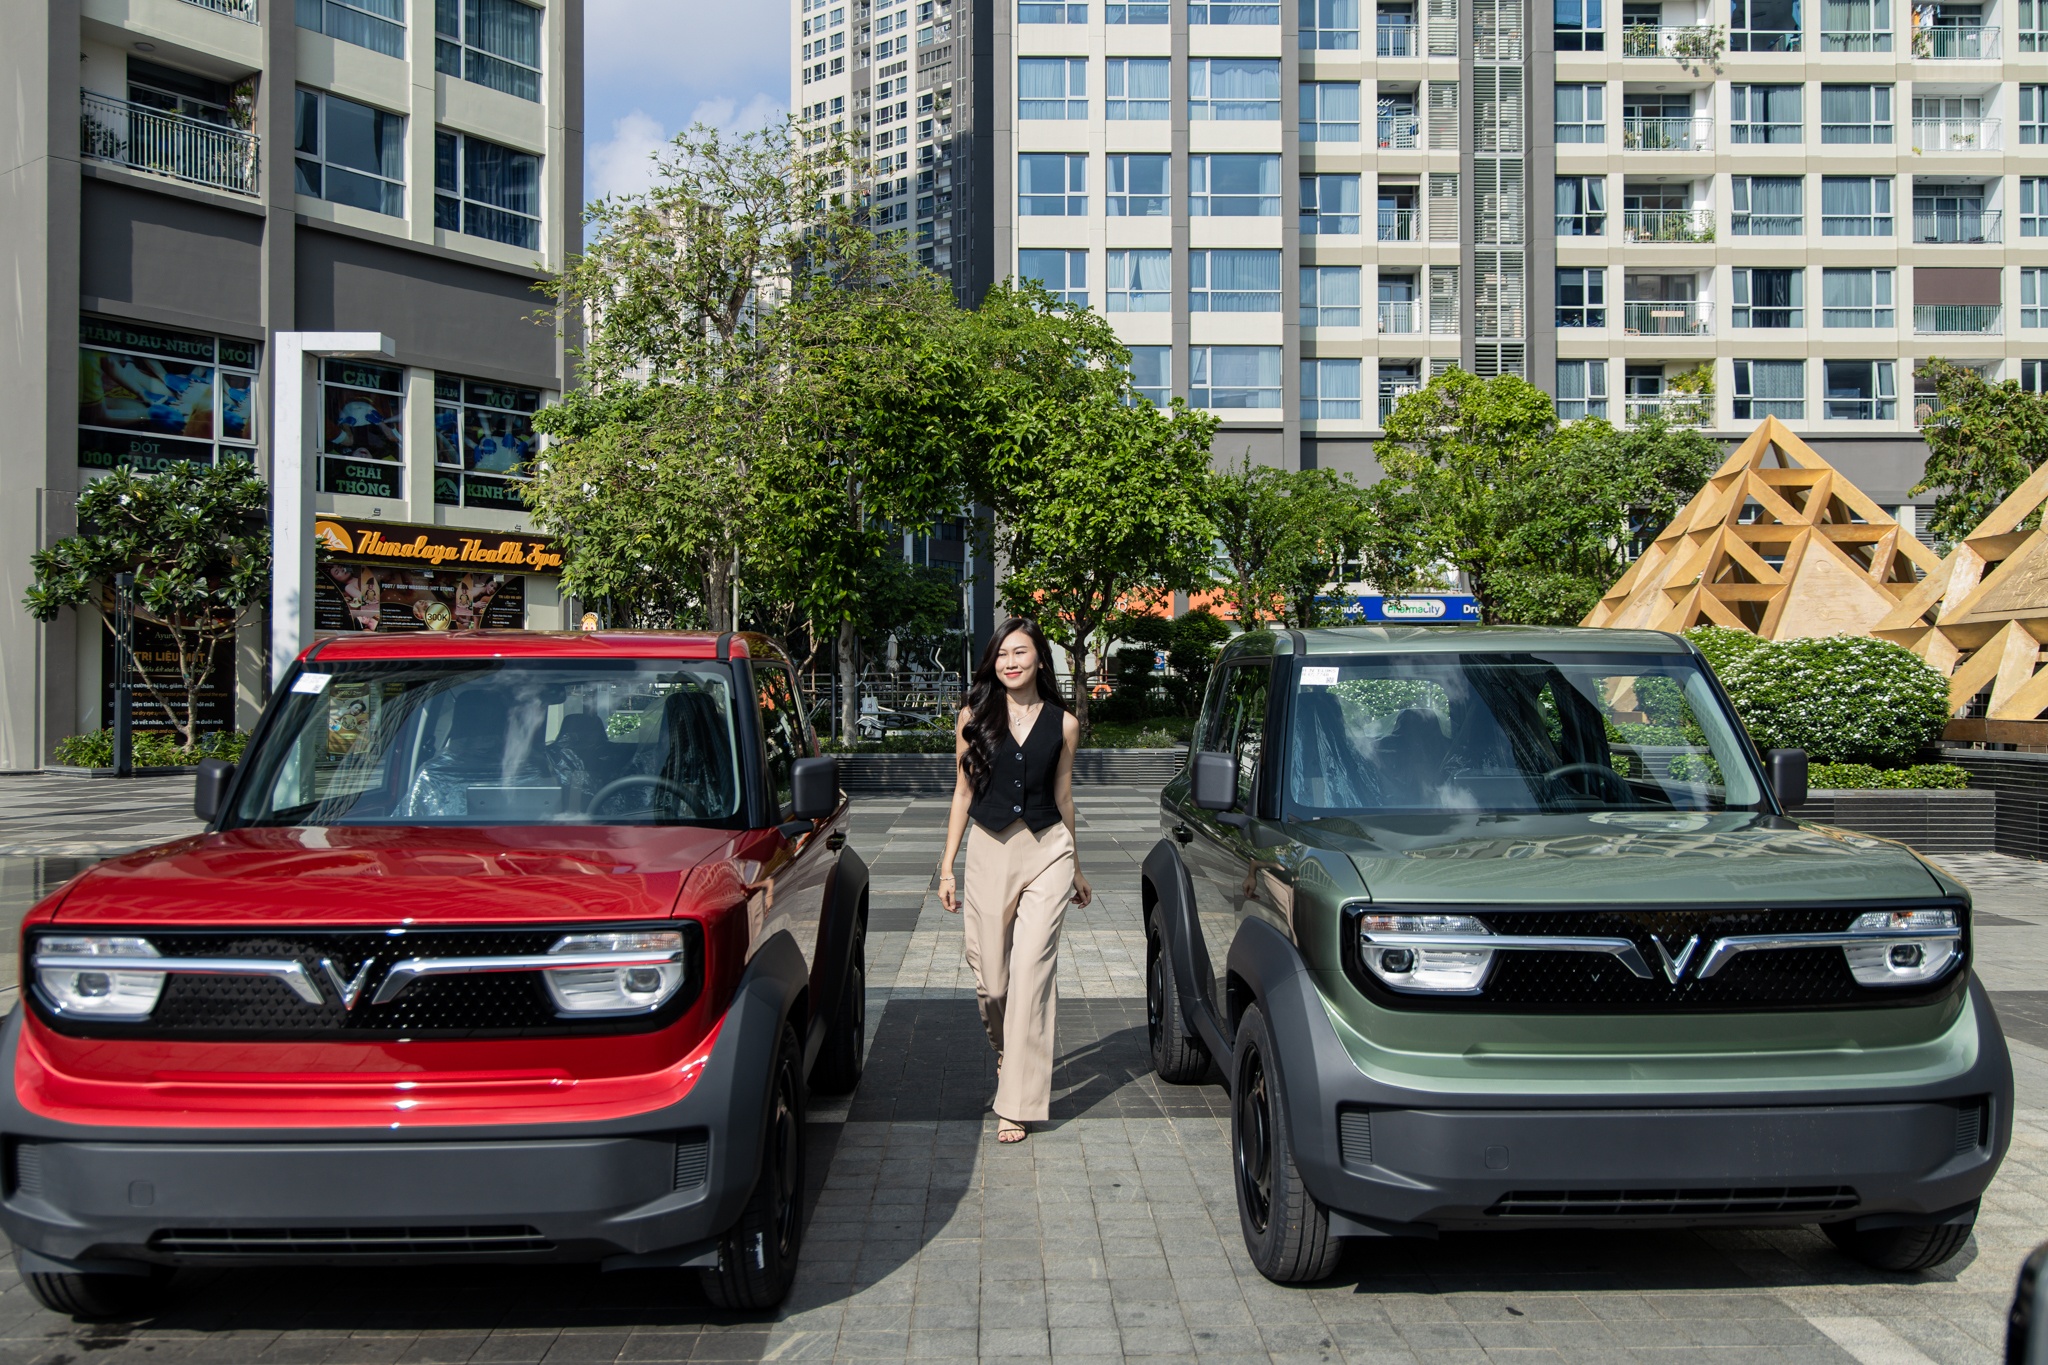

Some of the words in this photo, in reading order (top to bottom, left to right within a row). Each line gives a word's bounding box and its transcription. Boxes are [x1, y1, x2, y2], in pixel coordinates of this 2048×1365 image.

[79, 322, 122, 343] IẢM
[342, 369, 381, 389] CÂN
[130, 439, 161, 455] ĐỐT
[345, 464, 382, 480] CHẢI
[336, 479, 391, 497] THÔNG
[466, 483, 504, 500] KINH
[356, 529, 459, 565] Himalaya
[459, 538, 526, 565] Health
[525, 542, 563, 571] Spa
[427, 612, 448, 621] 300K
[1387, 603, 1441, 615] Pharmacity
[155, 631, 187, 640] Ayura
